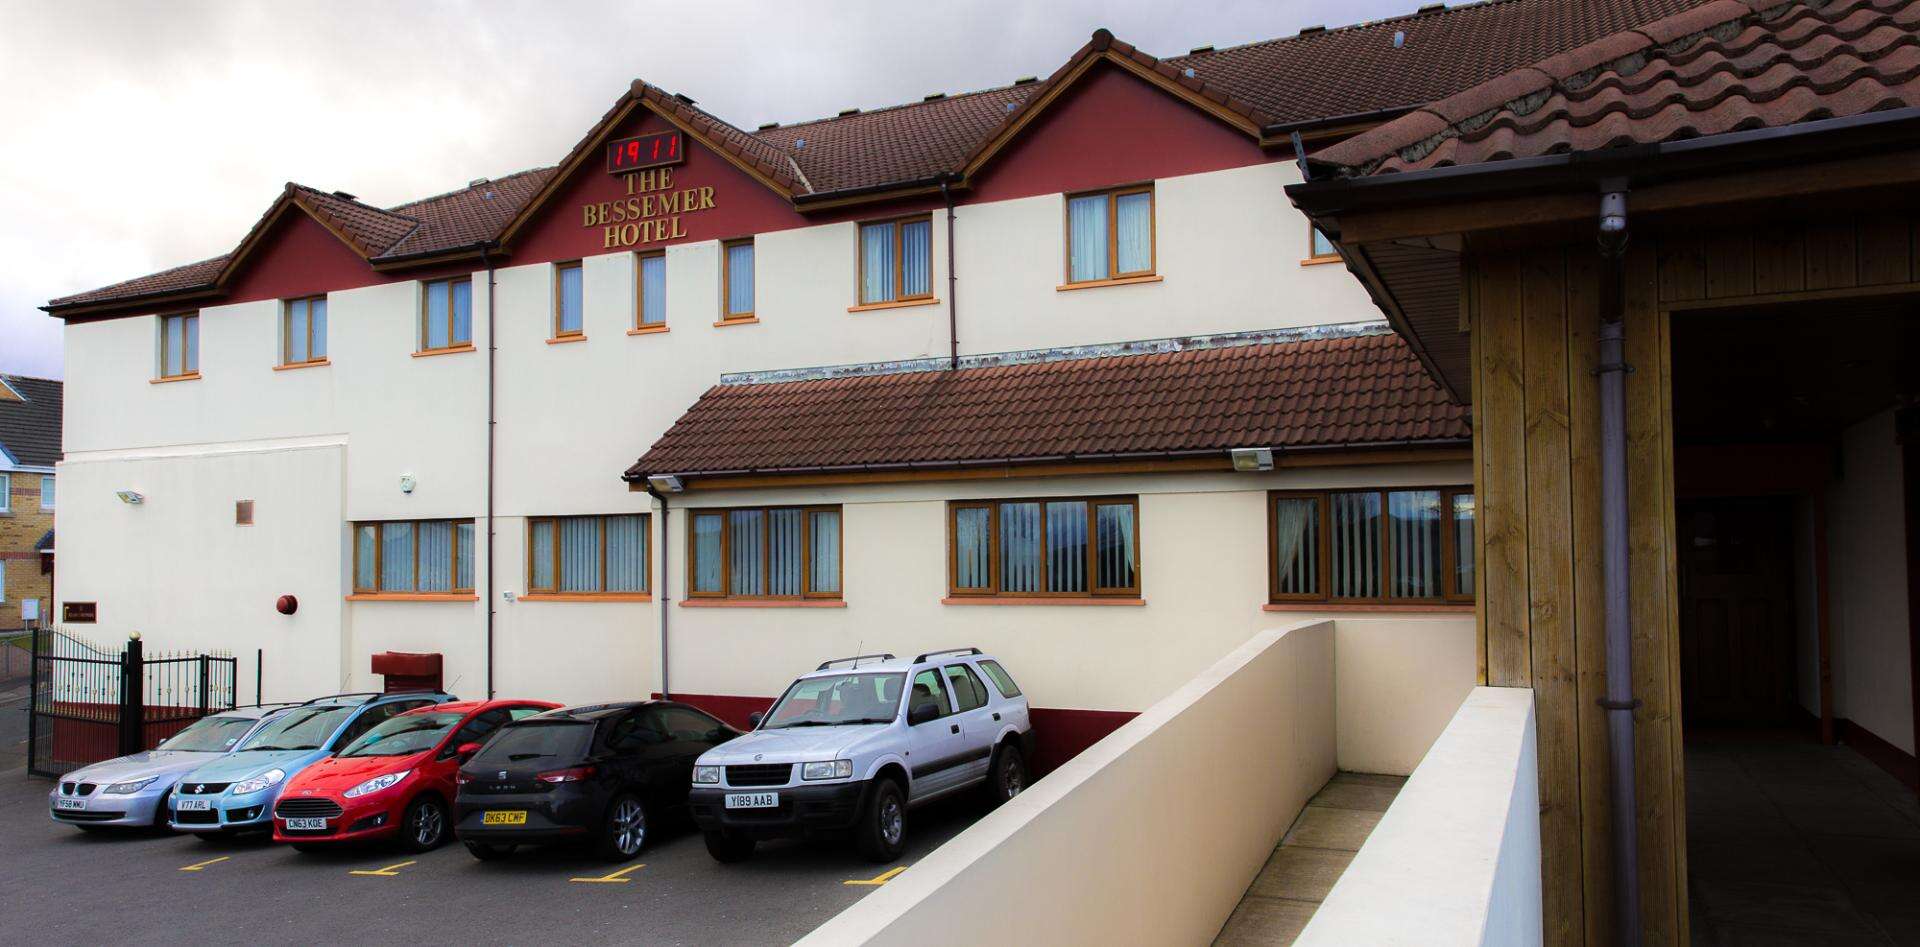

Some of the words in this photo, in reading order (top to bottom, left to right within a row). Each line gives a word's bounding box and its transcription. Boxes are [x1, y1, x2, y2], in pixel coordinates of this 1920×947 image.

[623, 167, 674, 195] THE
[582, 186, 716, 227] BESSEMER
[603, 216, 688, 248] HOTEL
[731, 795, 751, 806] Y189
[753, 795, 773, 806] AAB
